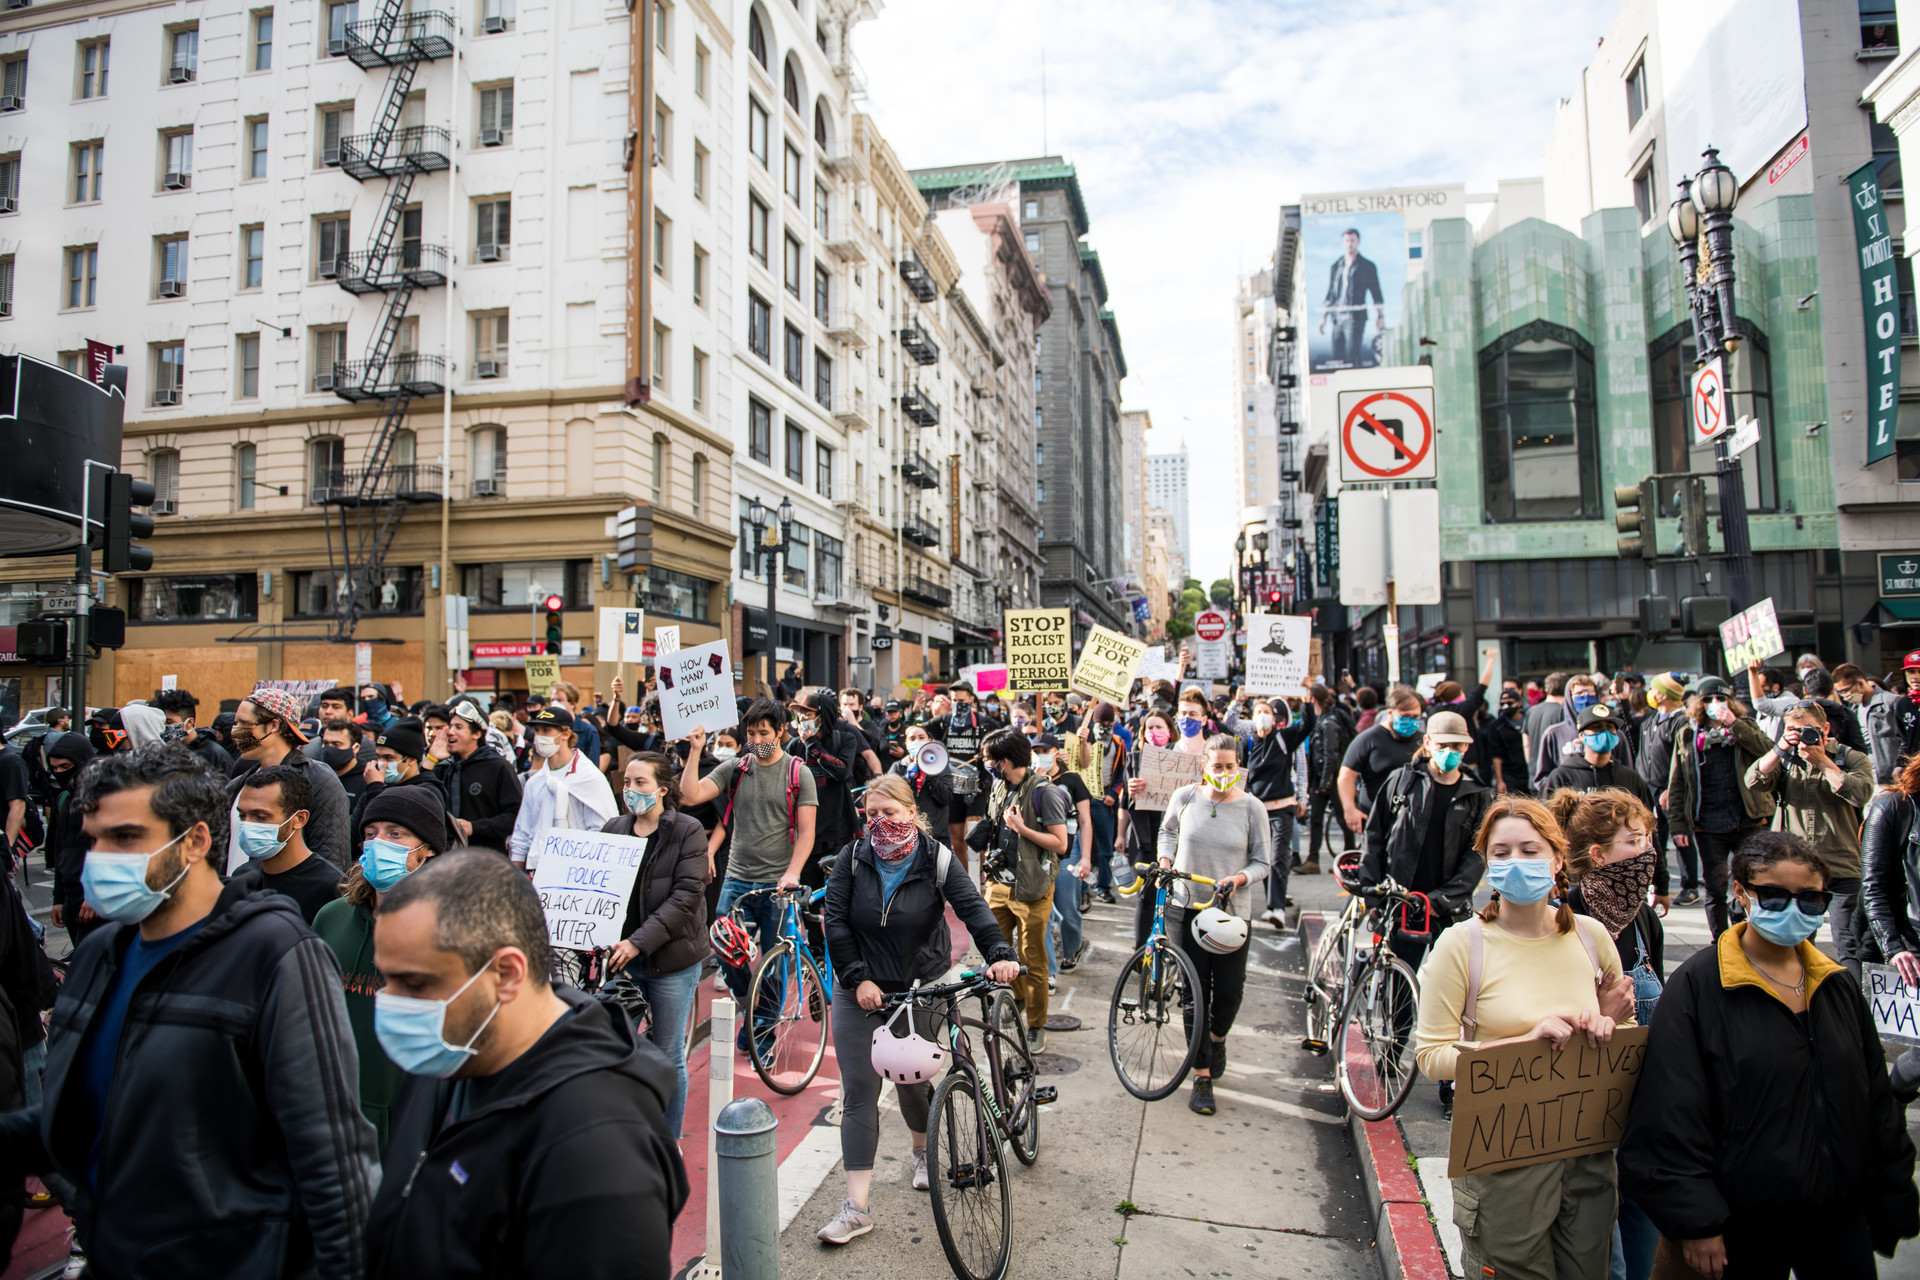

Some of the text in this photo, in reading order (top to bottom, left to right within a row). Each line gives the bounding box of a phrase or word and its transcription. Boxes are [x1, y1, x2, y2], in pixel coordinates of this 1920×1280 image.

[1304, 191, 1448, 214] HOTEL STRATFORD
[1862, 235, 1895, 269] MORITZ
[1872, 274, 1896, 446] HOTEL
[1328, 501, 1339, 566] WINE SHOP
[1317, 525, 1327, 584] COCKTAILS
[49, 599, 77, 608] O'Farr
[1010, 617, 1065, 632] STOP
[1722, 605, 1775, 649] FUCK
[476, 645, 540, 654] RETAIL FOR LEAE
[656, 630, 677, 656] HATE
[872, 638, 891, 648] UGG
[1011, 634, 1065, 646] RACIST
[1091, 632, 1141, 658] JUSTICE
[1725, 627, 1782, 674] RACISM
[680, 657, 702, 673] HOW
[1012, 653, 1066, 665] POLICE
[1094, 645, 1130, 667] FOR
[531, 668, 553, 677] FOR
[681, 670, 704, 686] MANY
[1010, 667, 1069, 678] TERROR
[1079, 666, 1105, 682] Floyd
[1083, 659, 1115, 677] George
[680, 683, 709, 697] WERENT
[1016, 680, 1063, 690] PSLweb.org
[678, 696, 720, 719] FILMED?
[1158, 751, 1203, 777] BLA
[544, 836, 644, 867] PROSECUTE THE
[567, 866, 612, 887] POLICE
[540, 892, 621, 920] BLACK LIVES
[1470, 1045, 1646, 1094] BLACK LIVES
[1464, 1088, 1623, 1168] MATTER
